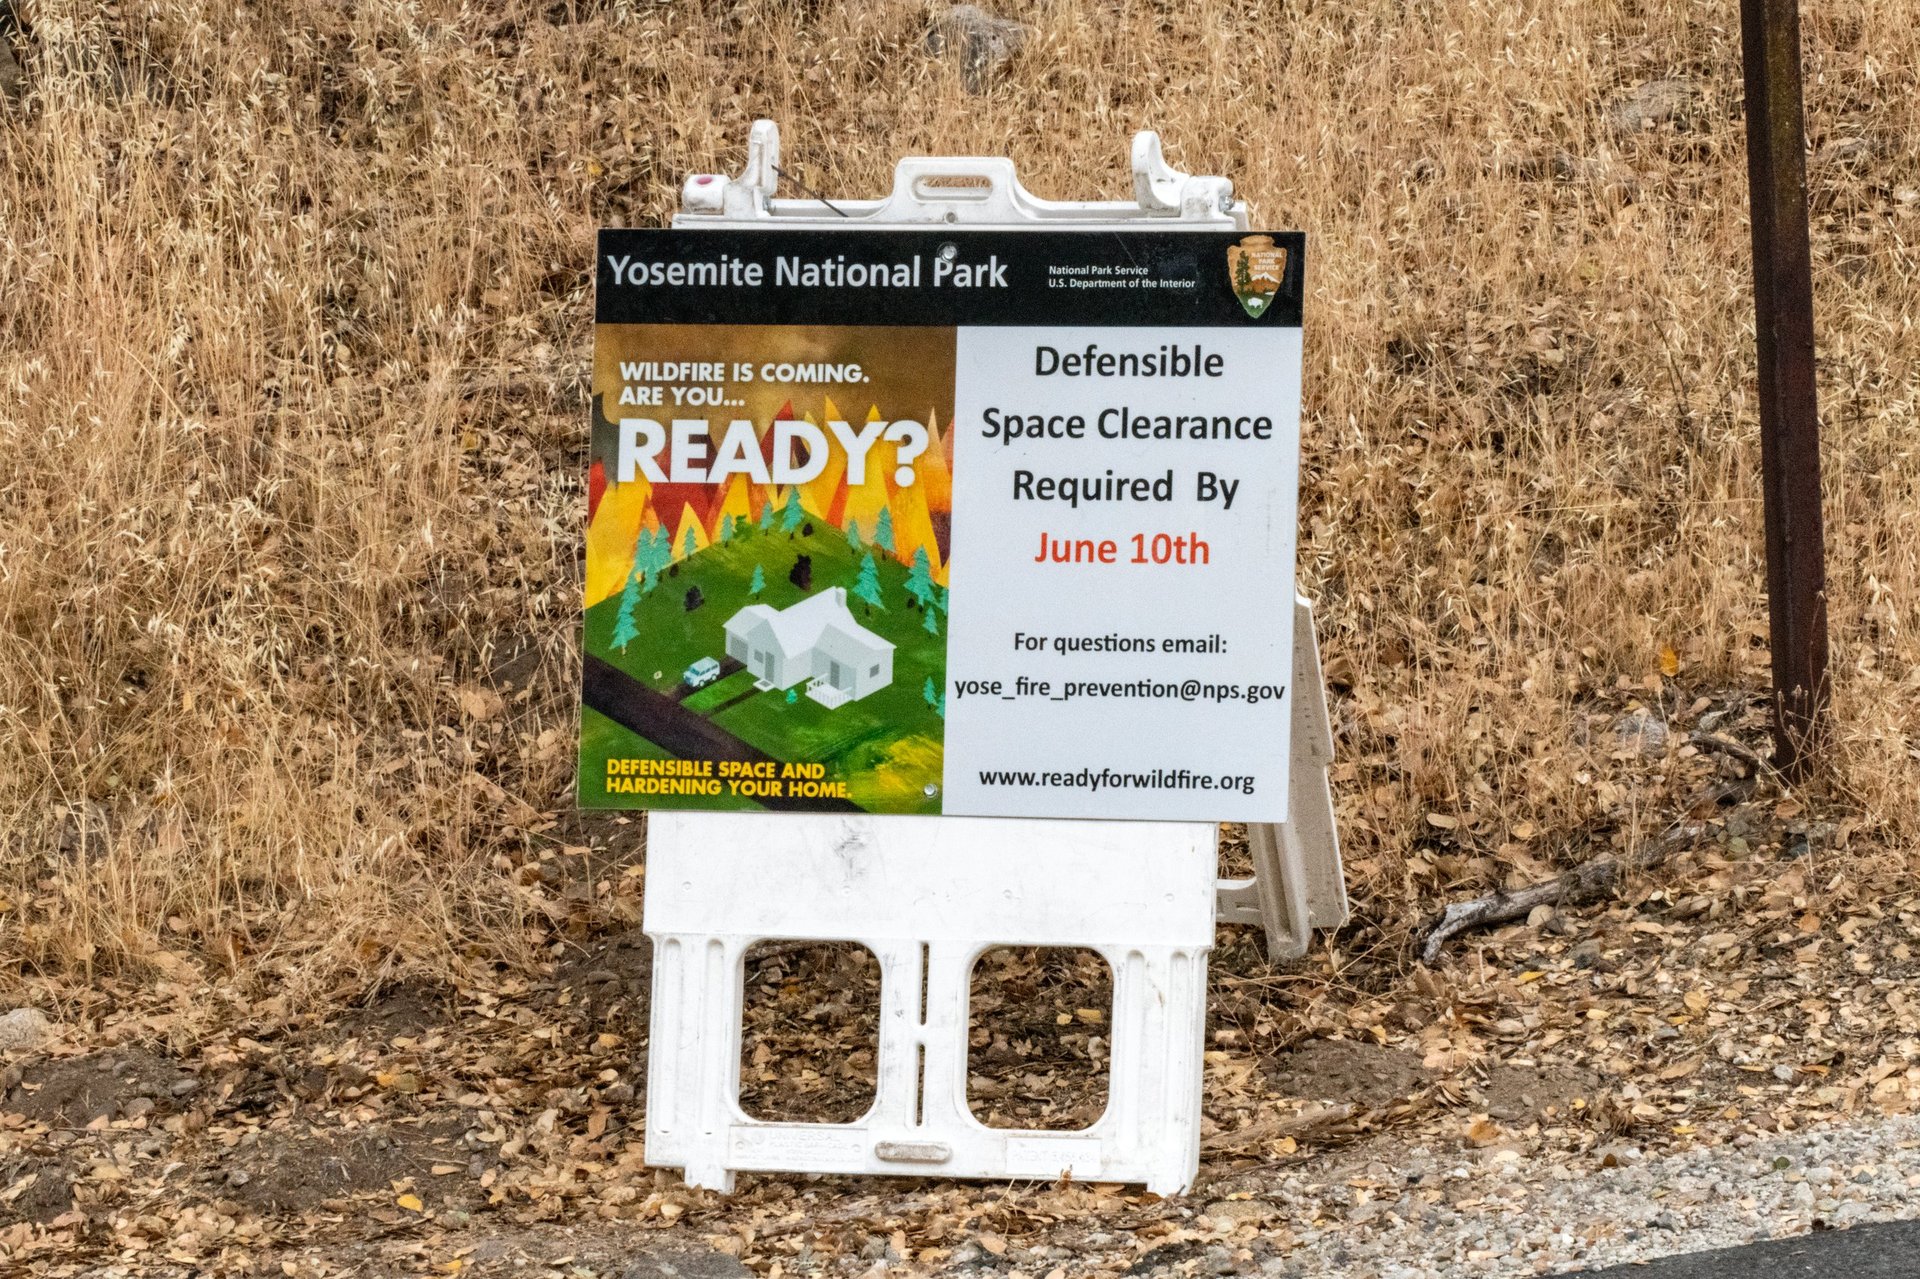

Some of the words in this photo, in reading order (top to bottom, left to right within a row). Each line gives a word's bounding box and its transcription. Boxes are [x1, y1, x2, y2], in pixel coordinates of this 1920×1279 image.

[607, 254, 763, 287] Yosemite
[775, 255, 920, 288] National
[933, 256, 1008, 289] Park
[1048, 278, 1067, 288] U.S.
[1069, 278, 1127, 290] Department
[1128, 278, 1140, 288] of
[1141, 278, 1158, 288] the
[1159, 279, 1196, 288] Interior
[1049, 265, 1089, 275] National
[1091, 265, 1113, 275] Park
[1115, 265, 1149, 275] Service
[619, 361, 725, 383] WILDFIRE
[732, 363, 754, 383] IS
[761, 363, 870, 384] COMING.
[1035, 344, 1224, 378] Defensible
[618, 386, 664, 406] ARE
[670, 386, 746, 407] YOU...
[981, 407, 1086, 443] Space
[1097, 406, 1273, 440] Clearance
[616, 418, 930, 488] READY?
[1013, 469, 1174, 509] Required
[1196, 471, 1240, 510] By
[1034, 532, 1118, 564] June
[1130, 531, 1210, 565] 10th
[1014, 632, 1048, 652] For
[1053, 633, 1156, 656] questions
[1161, 634, 1228, 654] email:
[954, 675, 1286, 704] yose_fire_prevention@nps.gov
[606, 759, 713, 778] DEFENSIBLE
[718, 761, 776, 779] SPACE
[781, 763, 825, 779] AND
[978, 767, 1256, 795] www.readyforwildfire.org
[606, 777, 722, 796] HARDENING
[728, 779, 783, 798] YOUR
[788, 781, 853, 799] HOME.
